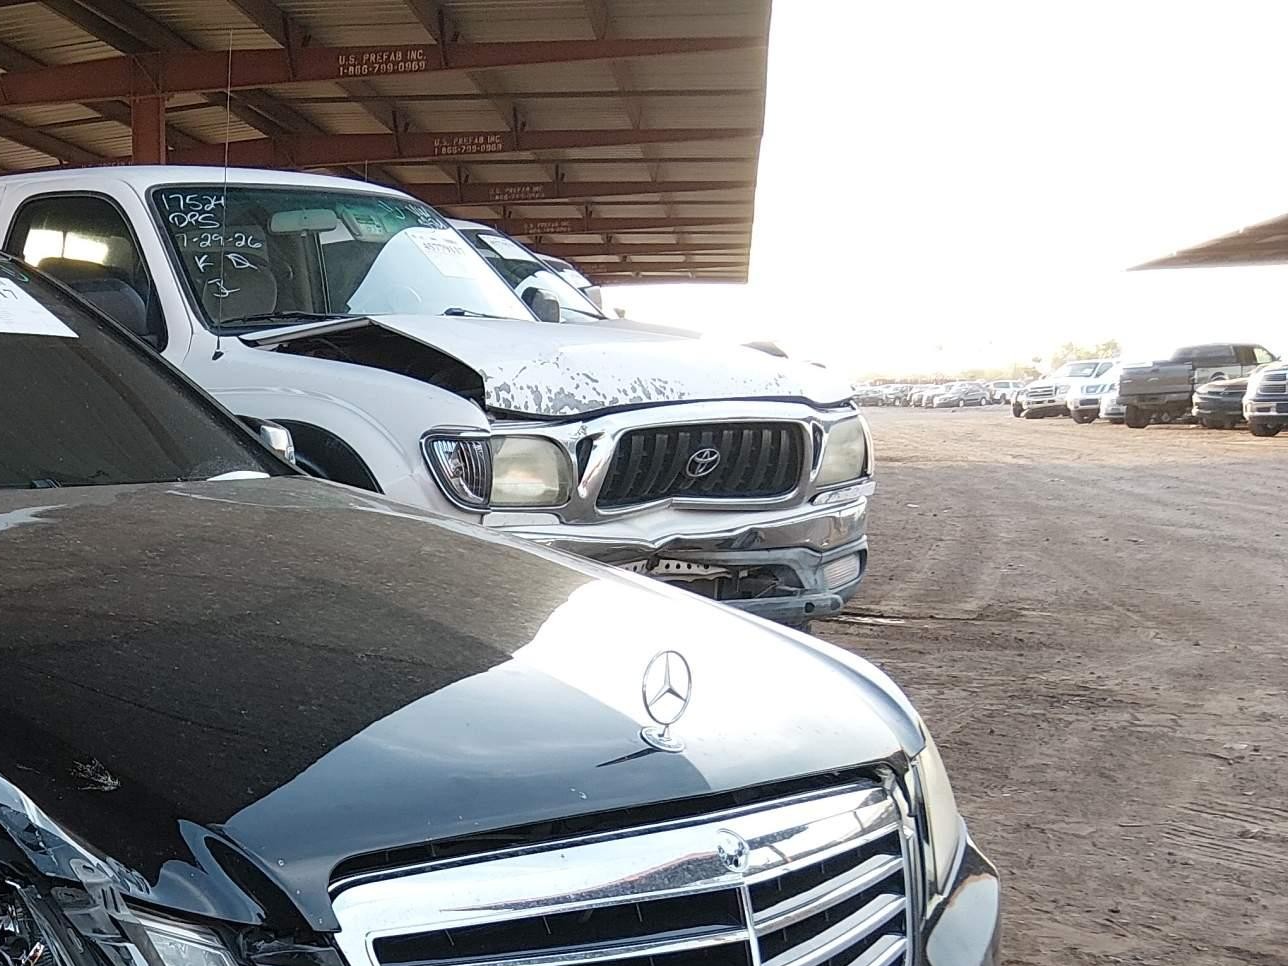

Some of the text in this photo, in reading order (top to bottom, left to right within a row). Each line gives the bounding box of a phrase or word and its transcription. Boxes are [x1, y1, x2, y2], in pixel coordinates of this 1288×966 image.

[338, 49, 427, 65] U.S. PREFAB INC.
[339, 61, 426, 76] 1-866-799-0969
[162, 194, 225, 211] 17524
[175, 233, 263, 248] 7-29-26
